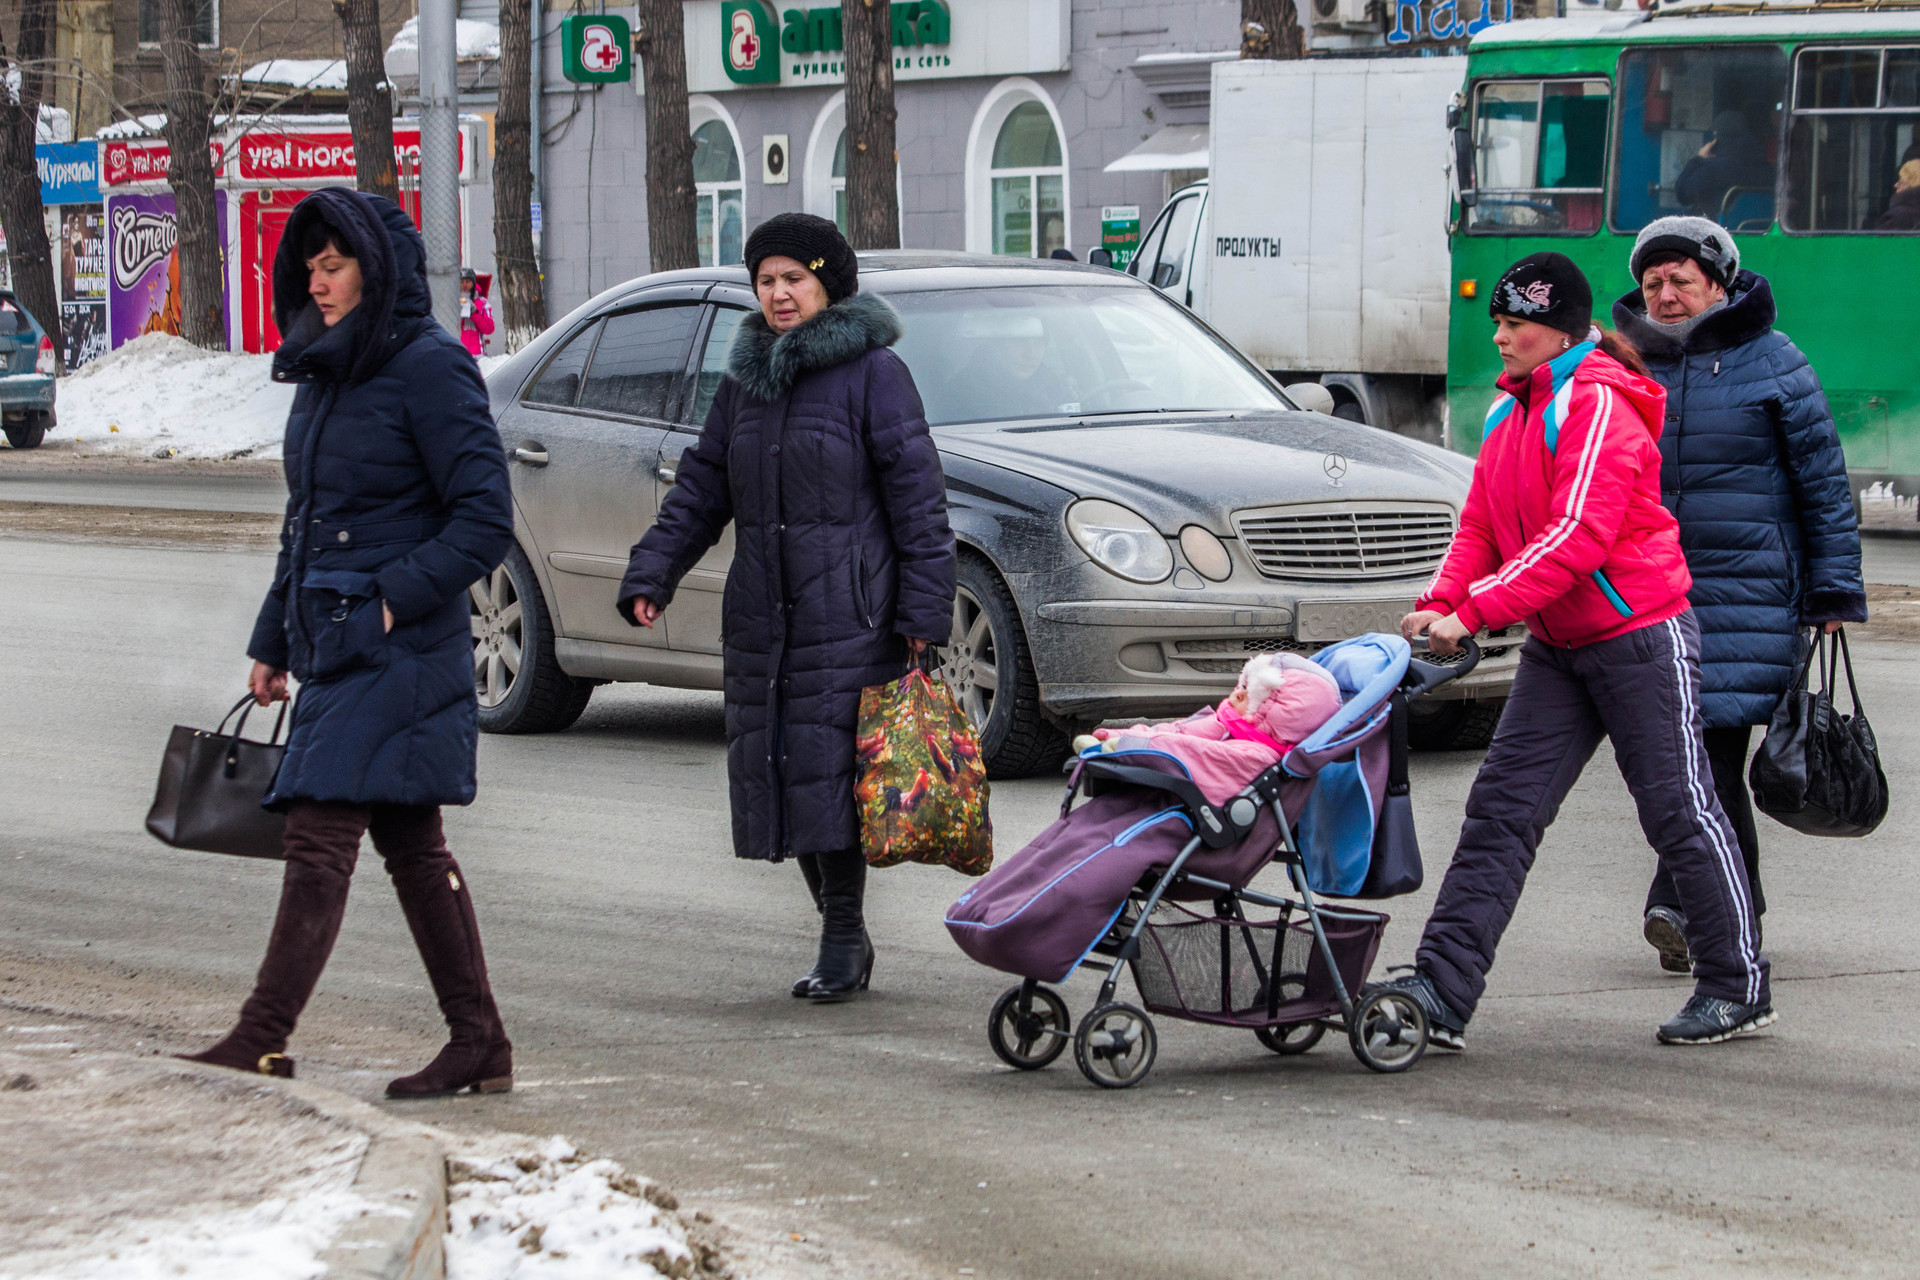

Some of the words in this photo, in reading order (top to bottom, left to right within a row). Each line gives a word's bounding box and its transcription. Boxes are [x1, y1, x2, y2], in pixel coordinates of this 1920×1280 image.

[782, 0, 950, 53] апка
[918, 54, 950, 68] сеть
[36, 157, 95, 189] Журналы
[112, 207, 178, 287] Cornetto
[1216, 237, 1281, 257] ПРОДУКТЫ
